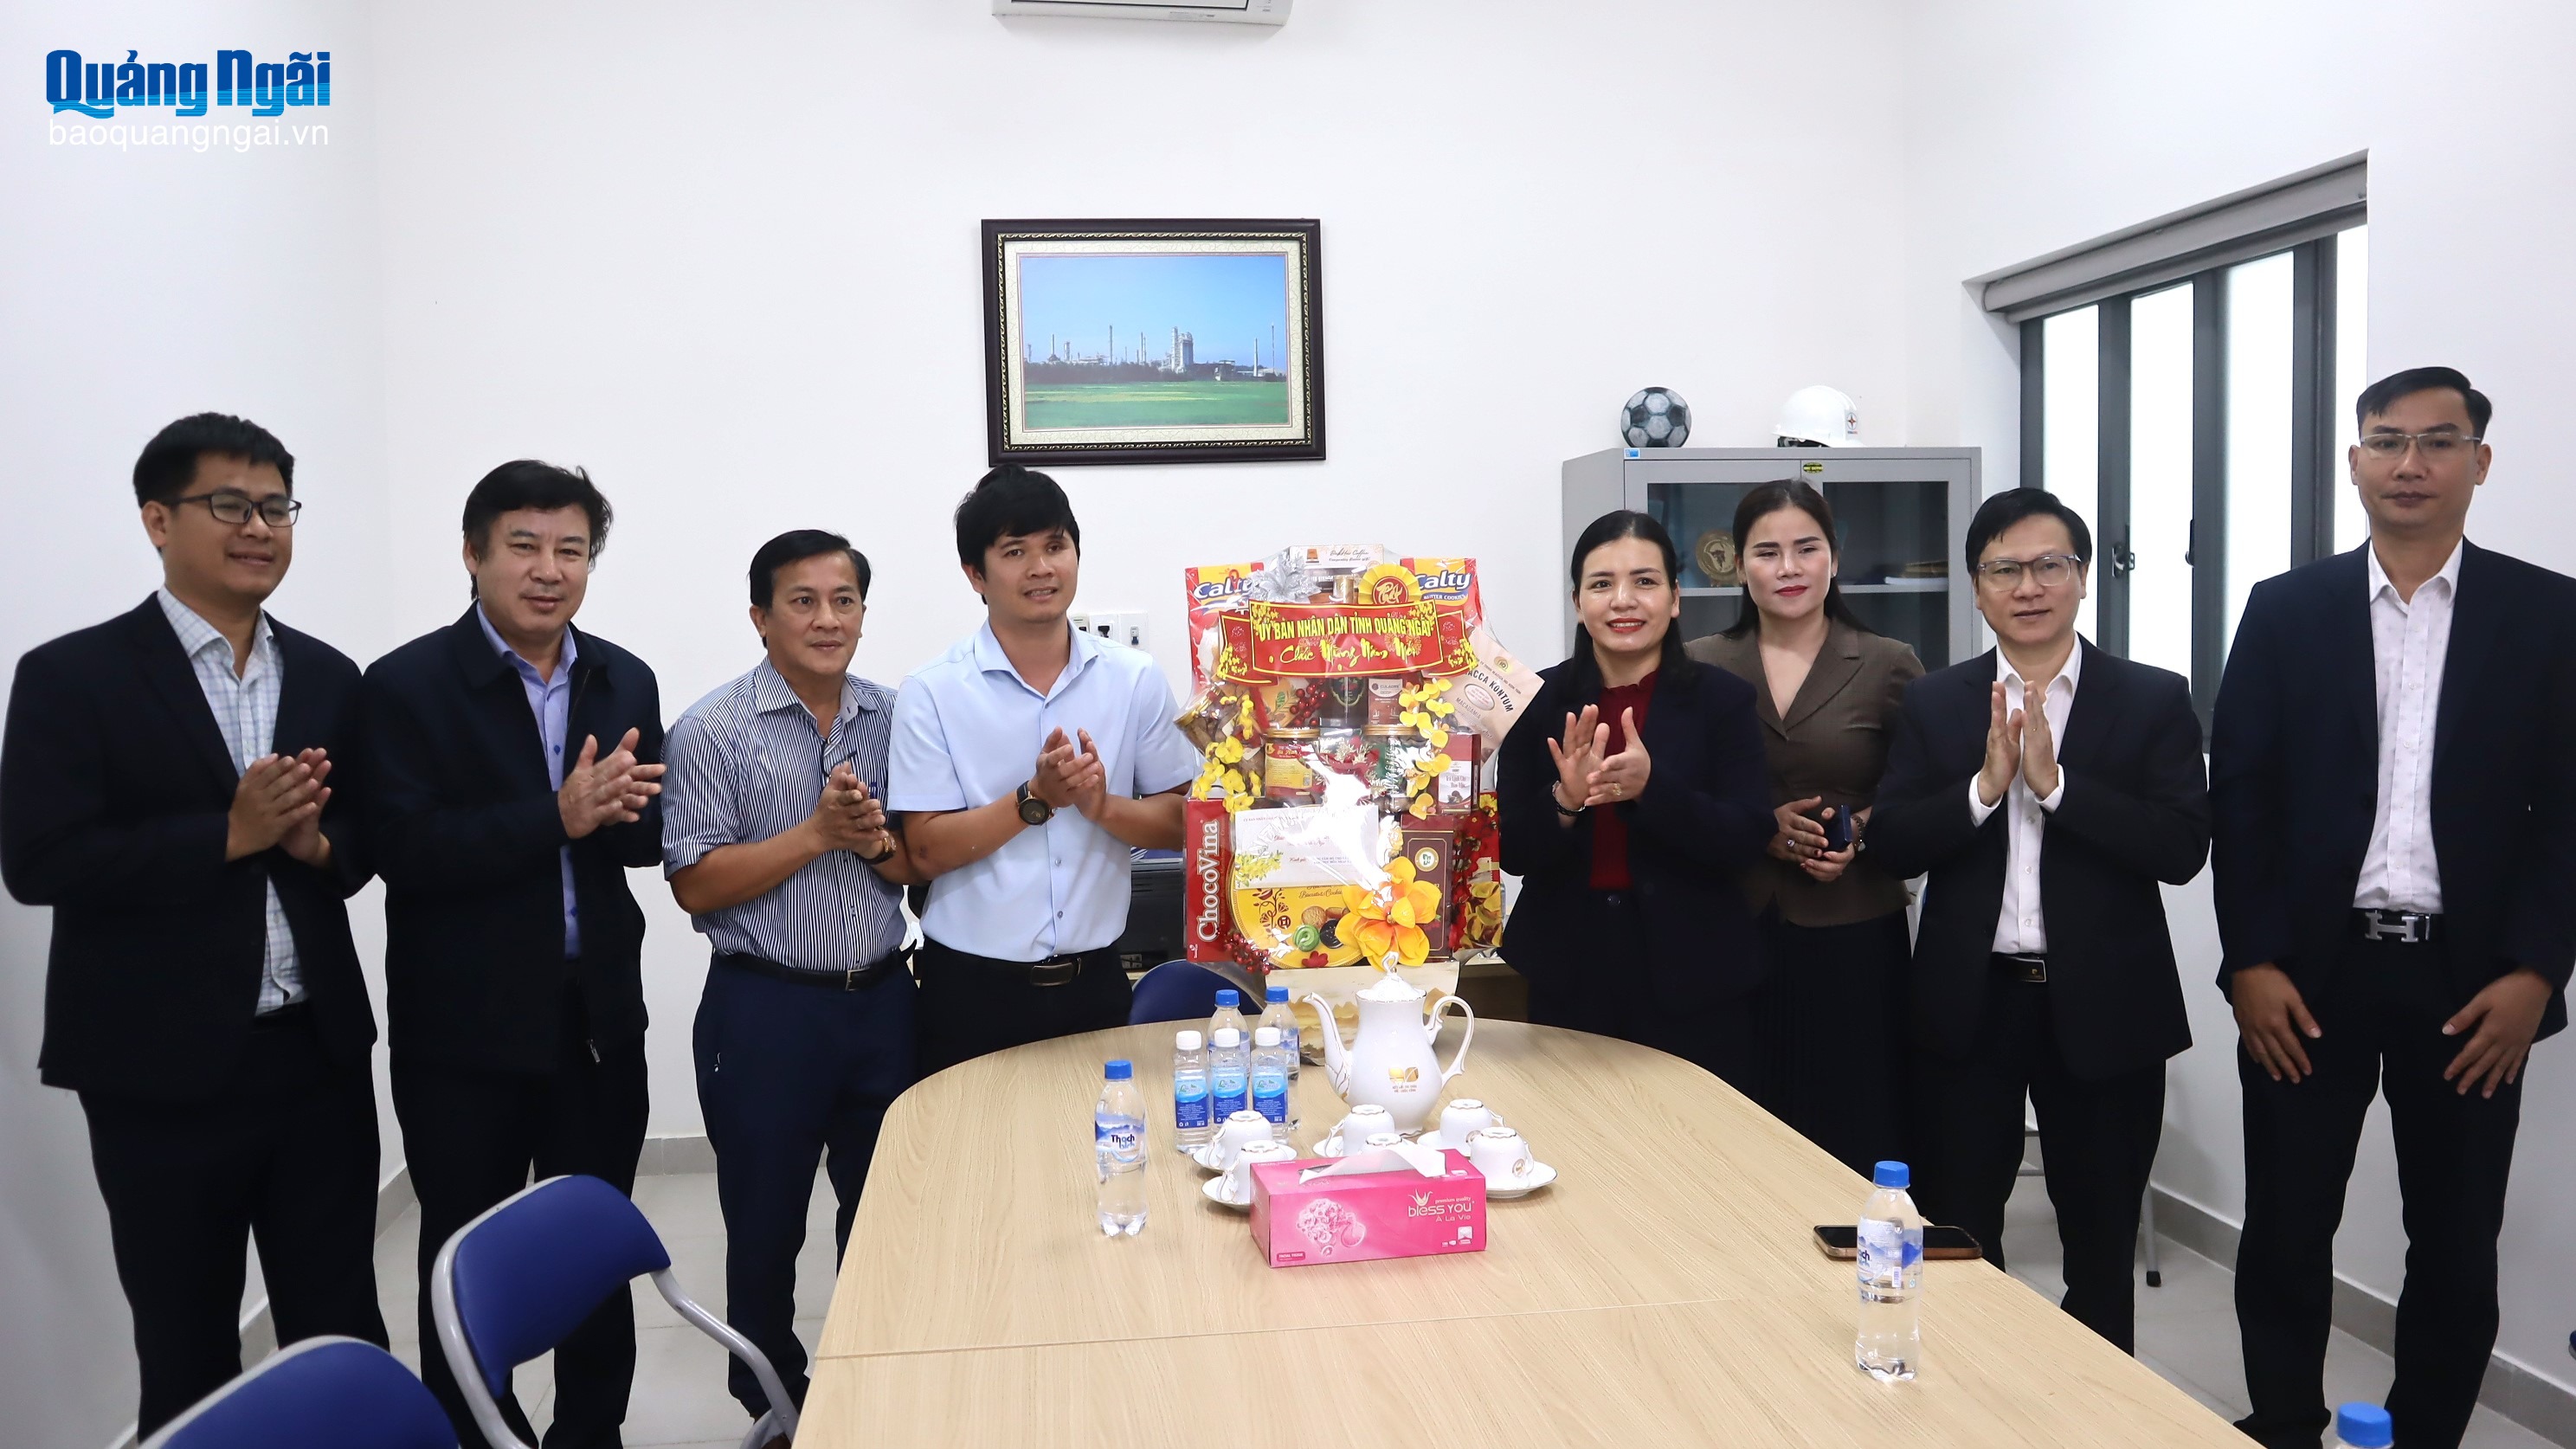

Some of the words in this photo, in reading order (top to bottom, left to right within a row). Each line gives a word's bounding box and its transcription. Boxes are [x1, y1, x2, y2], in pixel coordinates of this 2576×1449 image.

[1297, 615, 1325, 638] NHÂN
[1326, 612, 1349, 635] DÂN
[1349, 611, 1373, 634] TỈNH
[1374, 612, 1407, 636] QUẢNG
[1407, 614, 1432, 637] NGÃI
[1279, 644, 1317, 664] Chúc
[1465, 669, 1489, 685] ACCA
[1489, 680, 1514, 712] KONTUM
[1197, 819, 1220, 943] ChocoVina
[1408, 1204, 1446, 1218] bless
[1447, 1203, 1472, 1214] YOU
